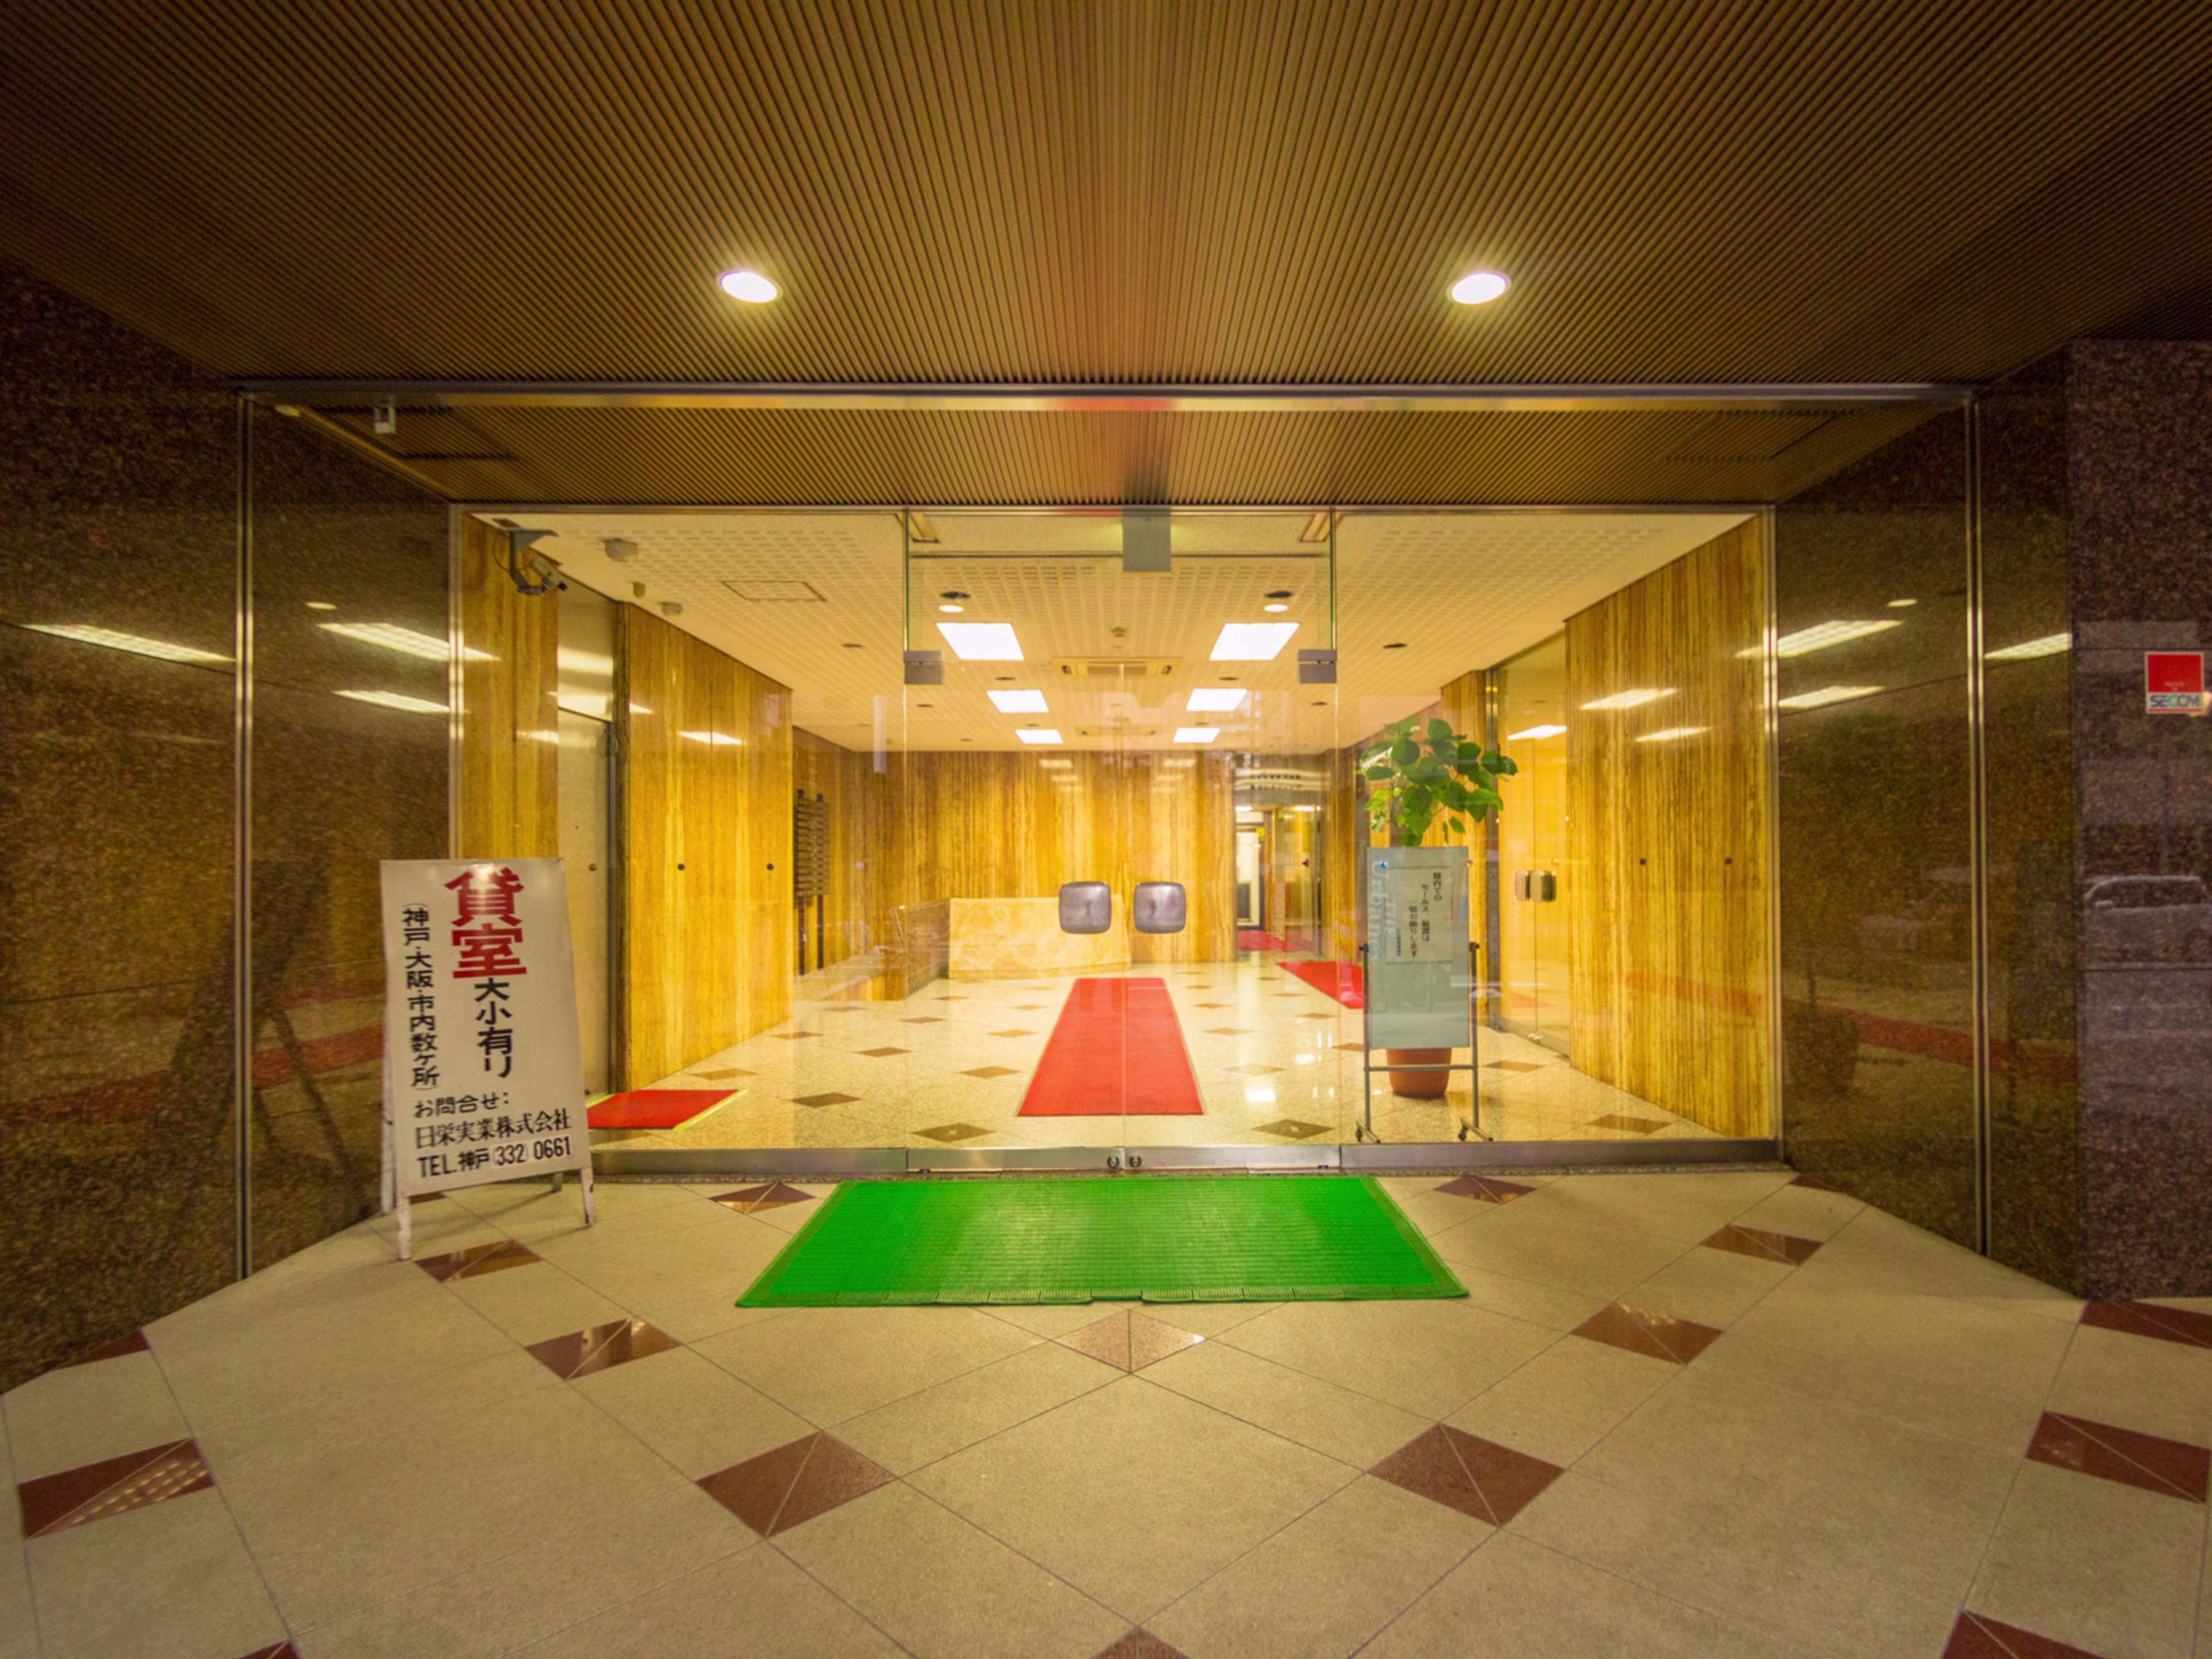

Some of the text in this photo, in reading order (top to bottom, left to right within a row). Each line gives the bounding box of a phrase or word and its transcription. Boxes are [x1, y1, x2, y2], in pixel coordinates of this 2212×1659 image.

[2150, 694, 2200, 708] SECOM
[444, 866, 527, 978] 貸室
[474, 978, 513, 1078] 大小有り
[415, 1108, 572, 1149] 日栄実業株式会社
[534, 1136, 571, 1160] 0661
